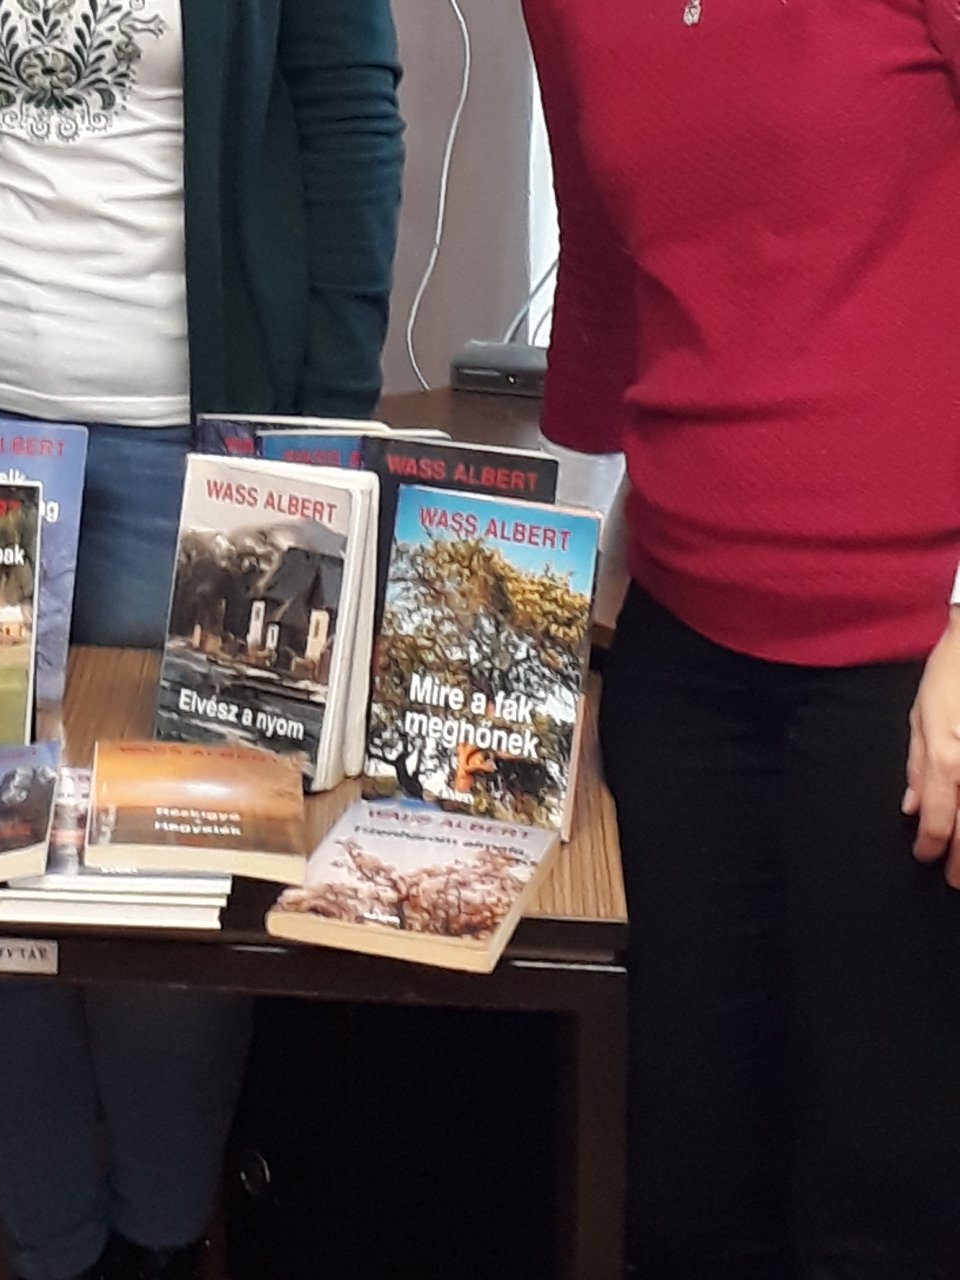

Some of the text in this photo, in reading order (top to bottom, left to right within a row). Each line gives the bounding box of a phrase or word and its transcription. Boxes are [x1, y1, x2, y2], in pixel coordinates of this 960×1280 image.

[386, 454, 446, 480] WASS
[453, 463, 538, 492] ALBERT
[207, 479, 338, 523] WASS ALBERT
[419, 507, 571, 551] WASS ALBERT
[178, 687, 304, 741] Elvész a nyom
[409, 671, 465, 710] Mire
[470, 691, 487, 716] a
